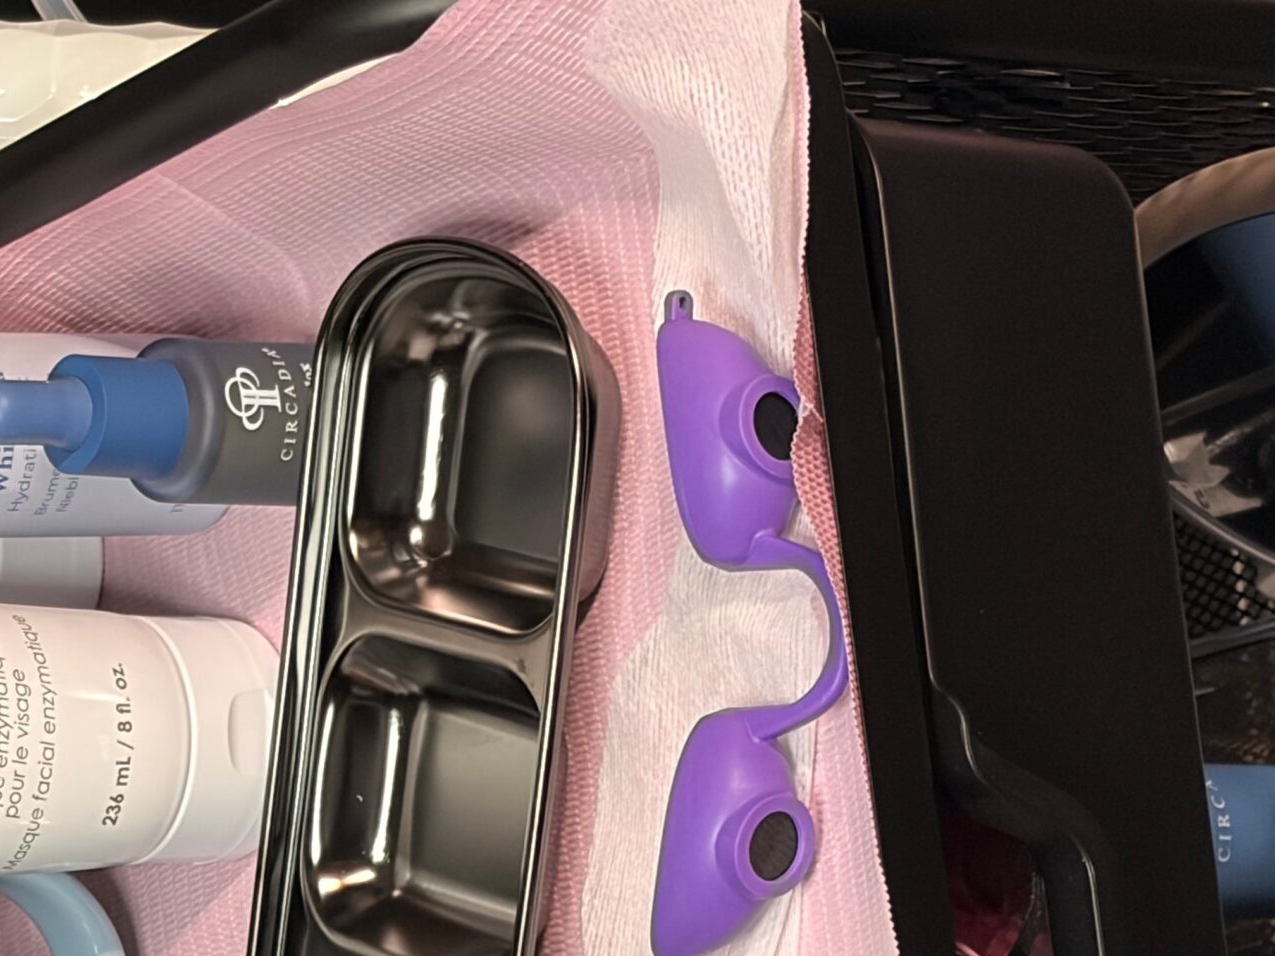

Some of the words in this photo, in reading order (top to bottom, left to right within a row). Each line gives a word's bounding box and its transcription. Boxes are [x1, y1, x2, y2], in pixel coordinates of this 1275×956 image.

[11, 614, 58, 735] enzymatique
[111, 663, 127, 690] oz.
[10, 668, 32, 739] visage
[116, 697, 131, 714] fl.
[117, 721, 132, 733] 8
[11, 746, 29, 764] le
[32, 741, 56, 801] facial
[115, 756, 131, 787] mL
[5, 770, 26, 819] pour
[101, 793, 125, 826] 236
[2, 807, 44, 870] Masque
